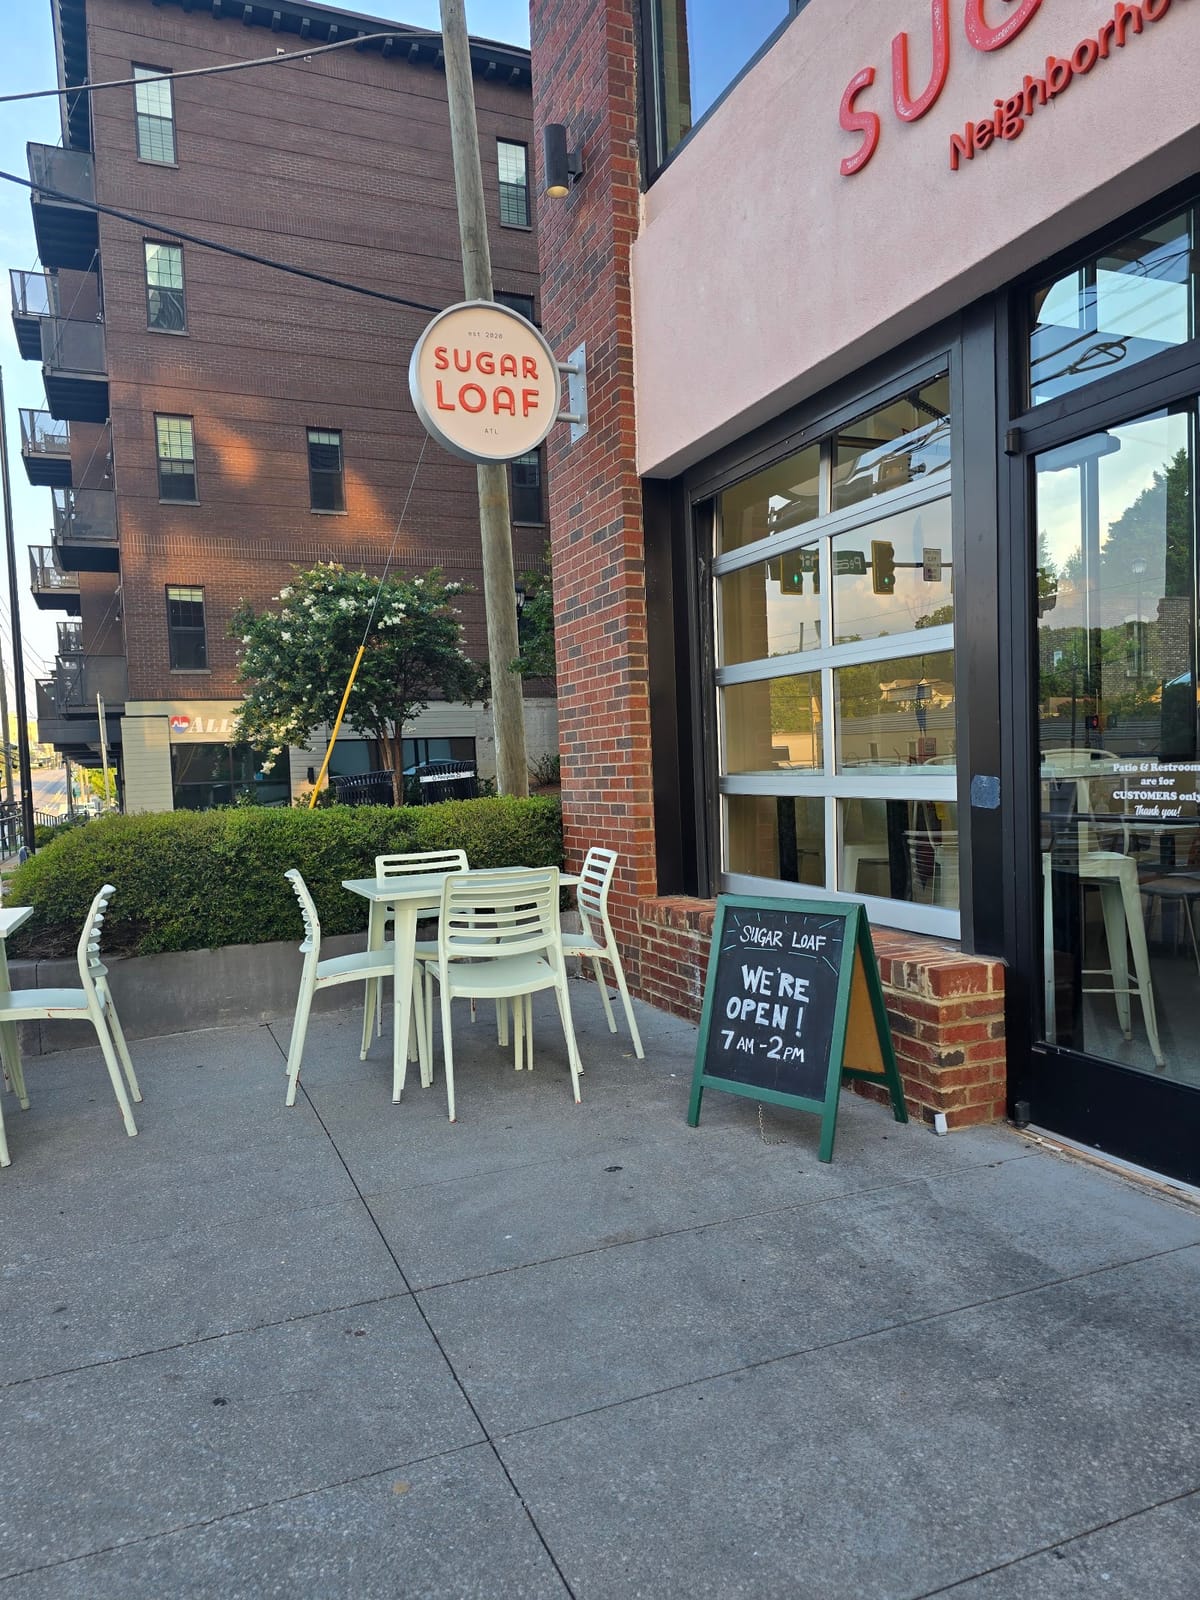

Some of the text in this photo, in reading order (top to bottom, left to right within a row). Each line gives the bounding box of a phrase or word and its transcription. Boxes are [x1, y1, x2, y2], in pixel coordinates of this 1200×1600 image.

[485, 331, 503, 340] 2020
[434, 346, 539, 380] SUGAR
[436, 380, 539, 417] LOAF
[1113, 763, 1138, 772] Patio
[1140, 763, 1149, 772] &
[1158, 776, 1175, 785] for
[1113, 791, 1200, 803] CUSTOMERS only
[1134, 804, 1182, 819] Thank you!
[739, 925, 826, 951] SUGAR LOAF
[741, 964, 810, 1003] WE'RE
